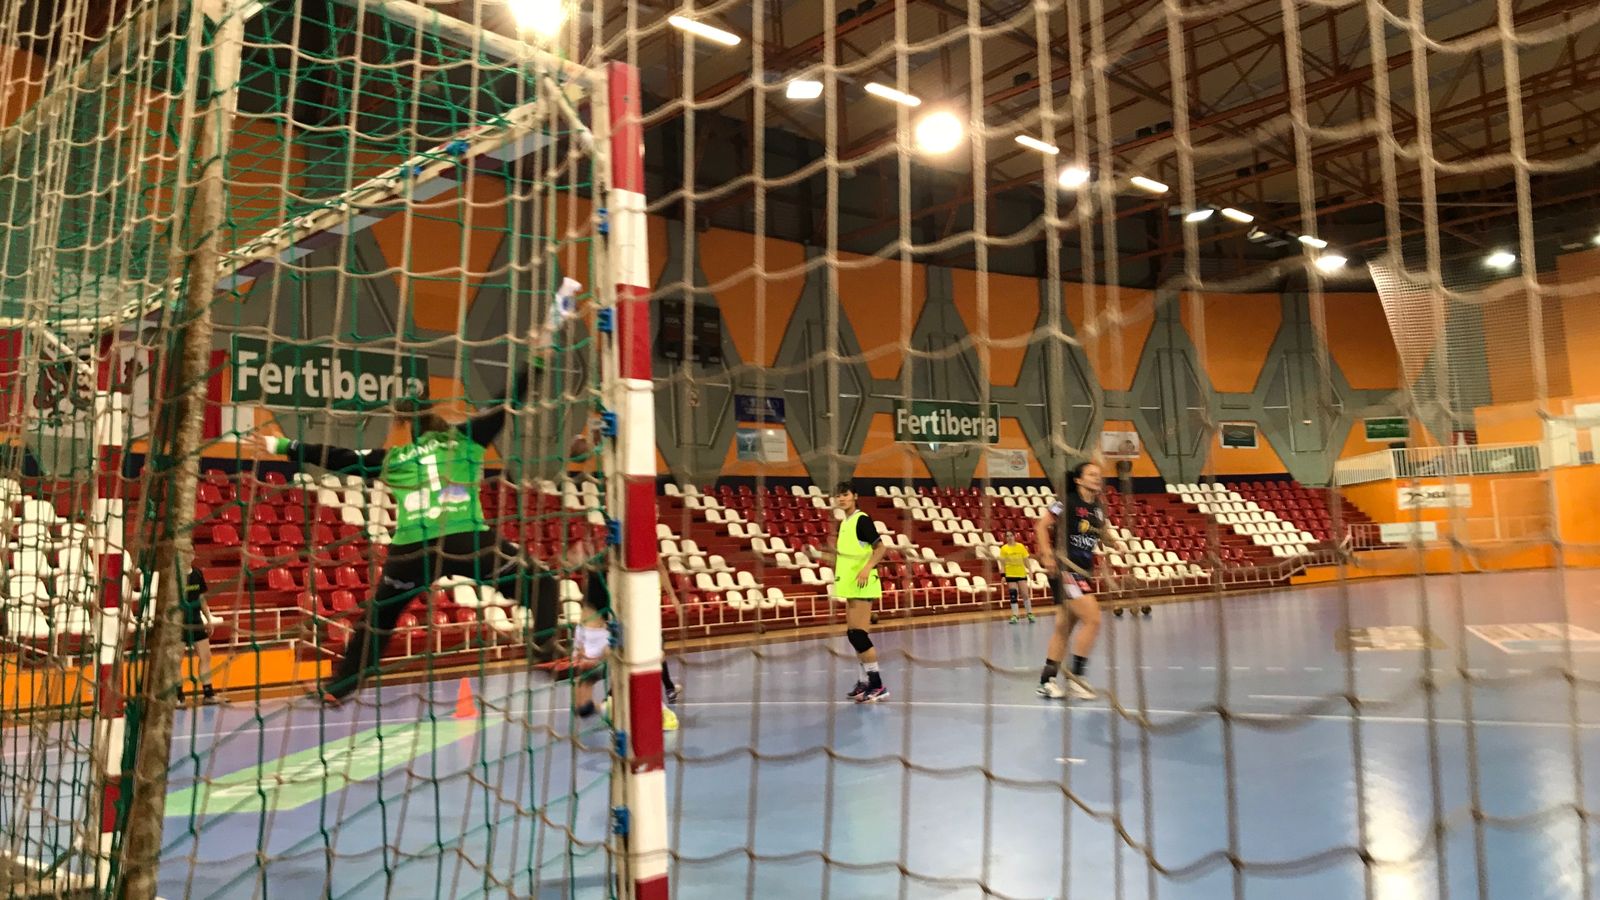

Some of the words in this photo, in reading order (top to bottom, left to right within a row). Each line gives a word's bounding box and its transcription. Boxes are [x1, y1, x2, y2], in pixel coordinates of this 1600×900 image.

[238, 350, 424, 401] Fertiberia
[896, 408, 997, 437] Fertiberia
[419, 454, 441, 491] 1
